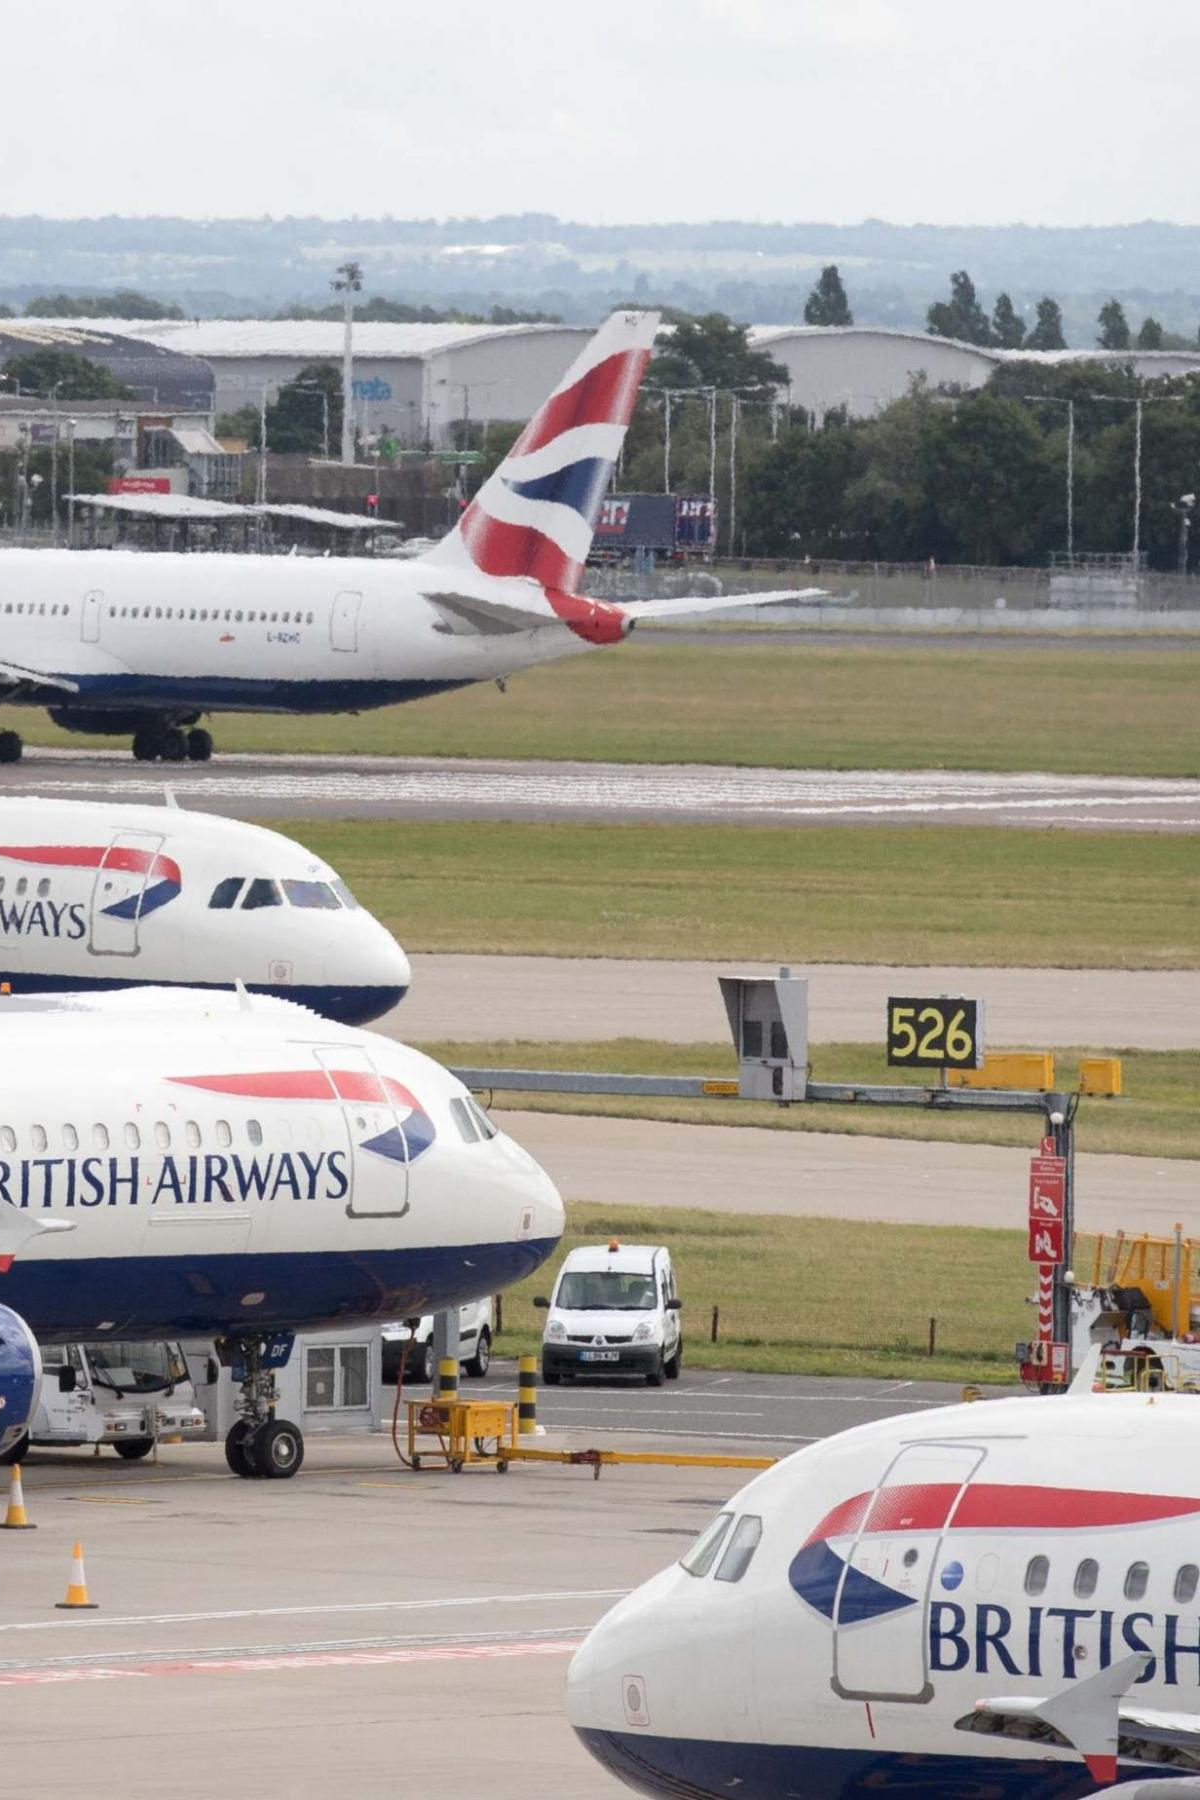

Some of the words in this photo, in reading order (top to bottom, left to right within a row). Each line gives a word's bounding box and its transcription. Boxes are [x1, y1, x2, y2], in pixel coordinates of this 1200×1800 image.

[892, 1007, 973, 1060] 526
[151, 1150, 349, 1205] AIRWAYS
[271, 1344, 288, 1357] DF
[929, 1600, 1200, 1686] BRITISH
